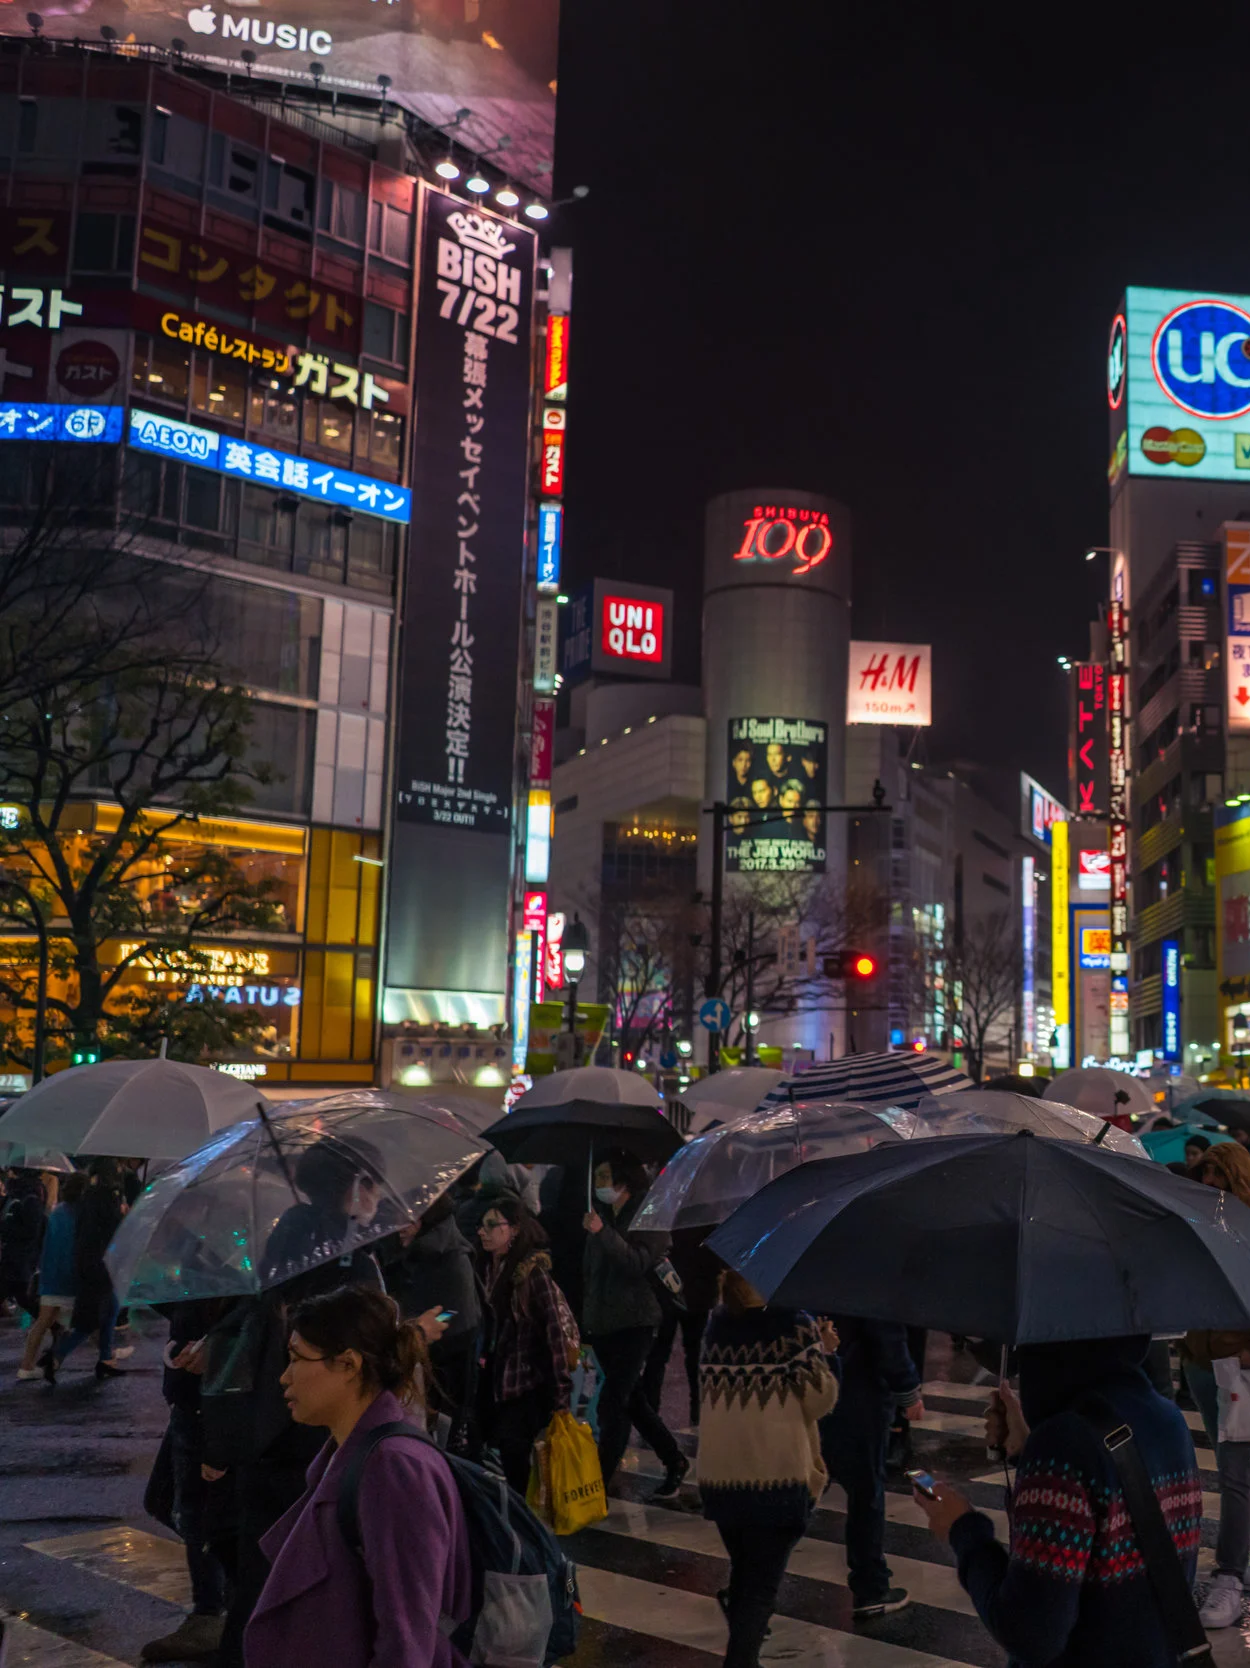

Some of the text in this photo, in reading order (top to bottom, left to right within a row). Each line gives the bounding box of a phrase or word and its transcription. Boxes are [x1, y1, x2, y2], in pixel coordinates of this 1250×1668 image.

[222, 14, 332, 55] MUSIC
[140, 226, 353, 333] コンタクト
[437, 237, 521, 305] BiSH
[437, 279, 518, 344] 7/22
[294, 353, 389, 410] ガスト
[71, 412, 100, 435] 6F
[139, 420, 209, 460] AEON
[223, 441, 405, 512] 英会話イーオン
[753, 505, 829, 525] SHIBUYA
[733, 517, 832, 574] 109
[610, 602, 653, 632] UNI
[609, 627, 656, 655] QLO
[860, 653, 921, 694] H&M
[1094, 665, 1104, 710] TOKYO
[865, 702, 902, 714] 150m
[1079, 665, 1094, 811] KATE
